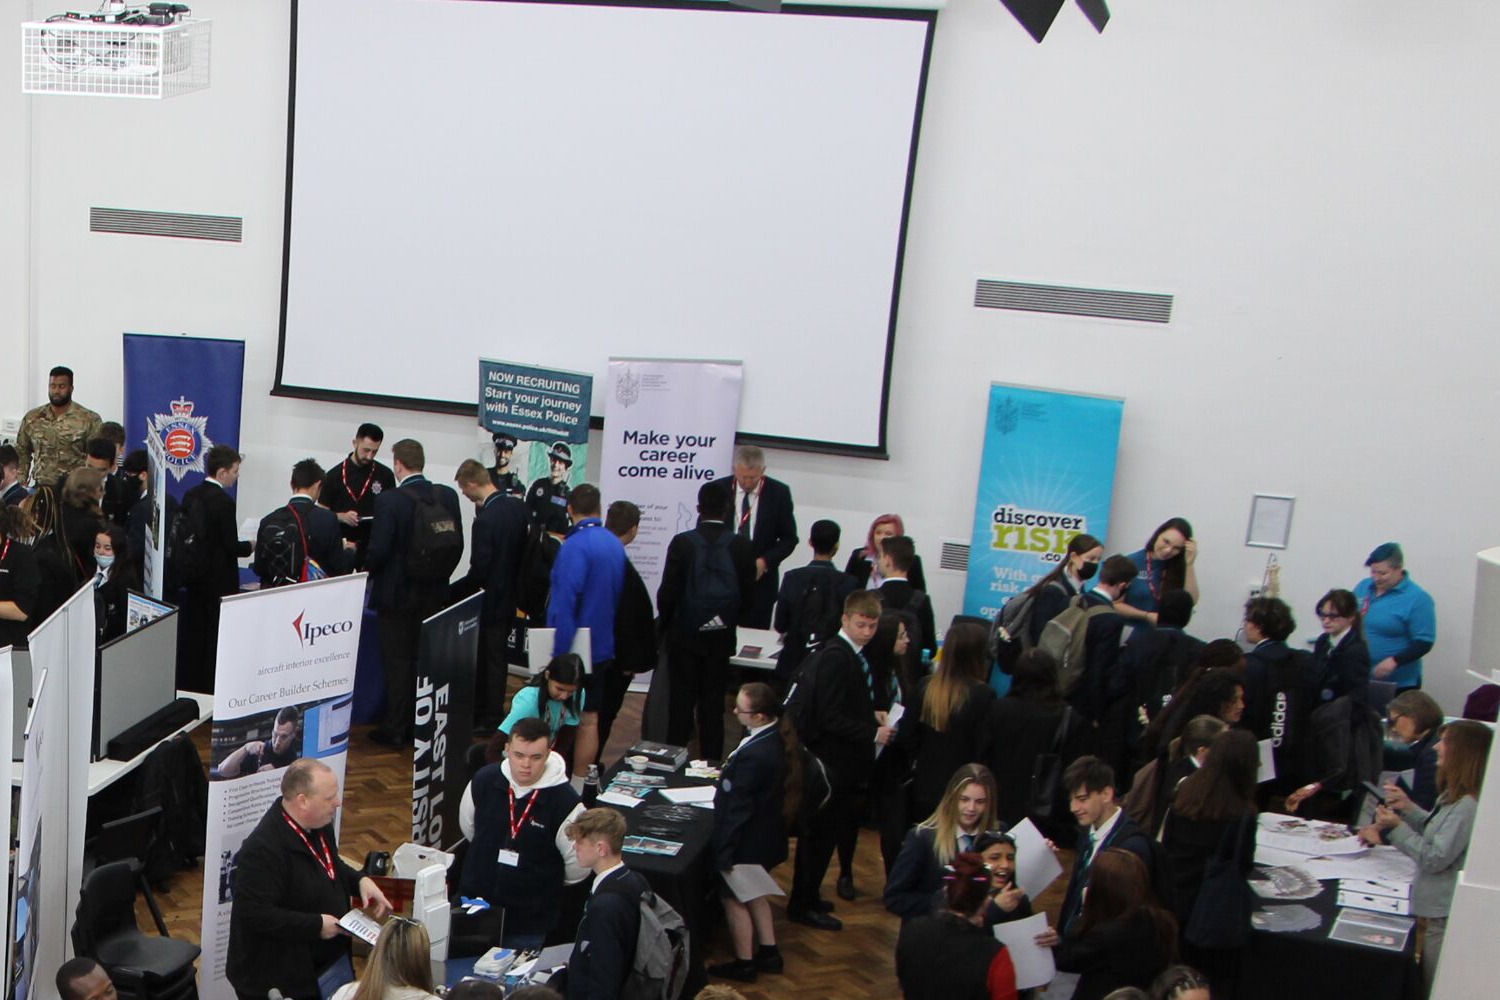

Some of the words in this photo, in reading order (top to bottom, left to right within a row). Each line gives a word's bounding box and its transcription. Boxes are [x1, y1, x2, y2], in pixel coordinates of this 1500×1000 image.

[488, 371, 514, 384] NOW
[516, 375, 580, 394] RECRUITING
[485, 386, 512, 400] Start
[515, 393, 539, 404] your
[540, 396, 582, 414] journey
[486, 402, 508, 414] with
[511, 405, 543, 420] Essex
[546, 410, 578, 426] Police
[622, 430, 670, 446] Make
[675, 435, 716, 450] your
[639, 449, 697, 463] career
[618, 464, 668, 478] come
[672, 464, 715, 480] alive
[993, 508, 1083, 530] discover
[992, 524, 1084, 554] risk
[994, 566, 1028, 581] With
[990, 581, 1019, 592] risk
[304, 620, 353, 646] Ipeco
[257, 664, 284, 676] aircraft
[286, 658, 313, 672] interior
[314, 651, 351, 665] excellence
[228, 697, 248, 709] Our
[248, 690, 278, 704] Career
[280, 682, 311, 698] Builder
[312, 677, 349, 691] Schemes
[415, 676, 434, 726] OF
[432, 682, 449, 782] EAST
[1271, 692, 1286, 748] adidas
